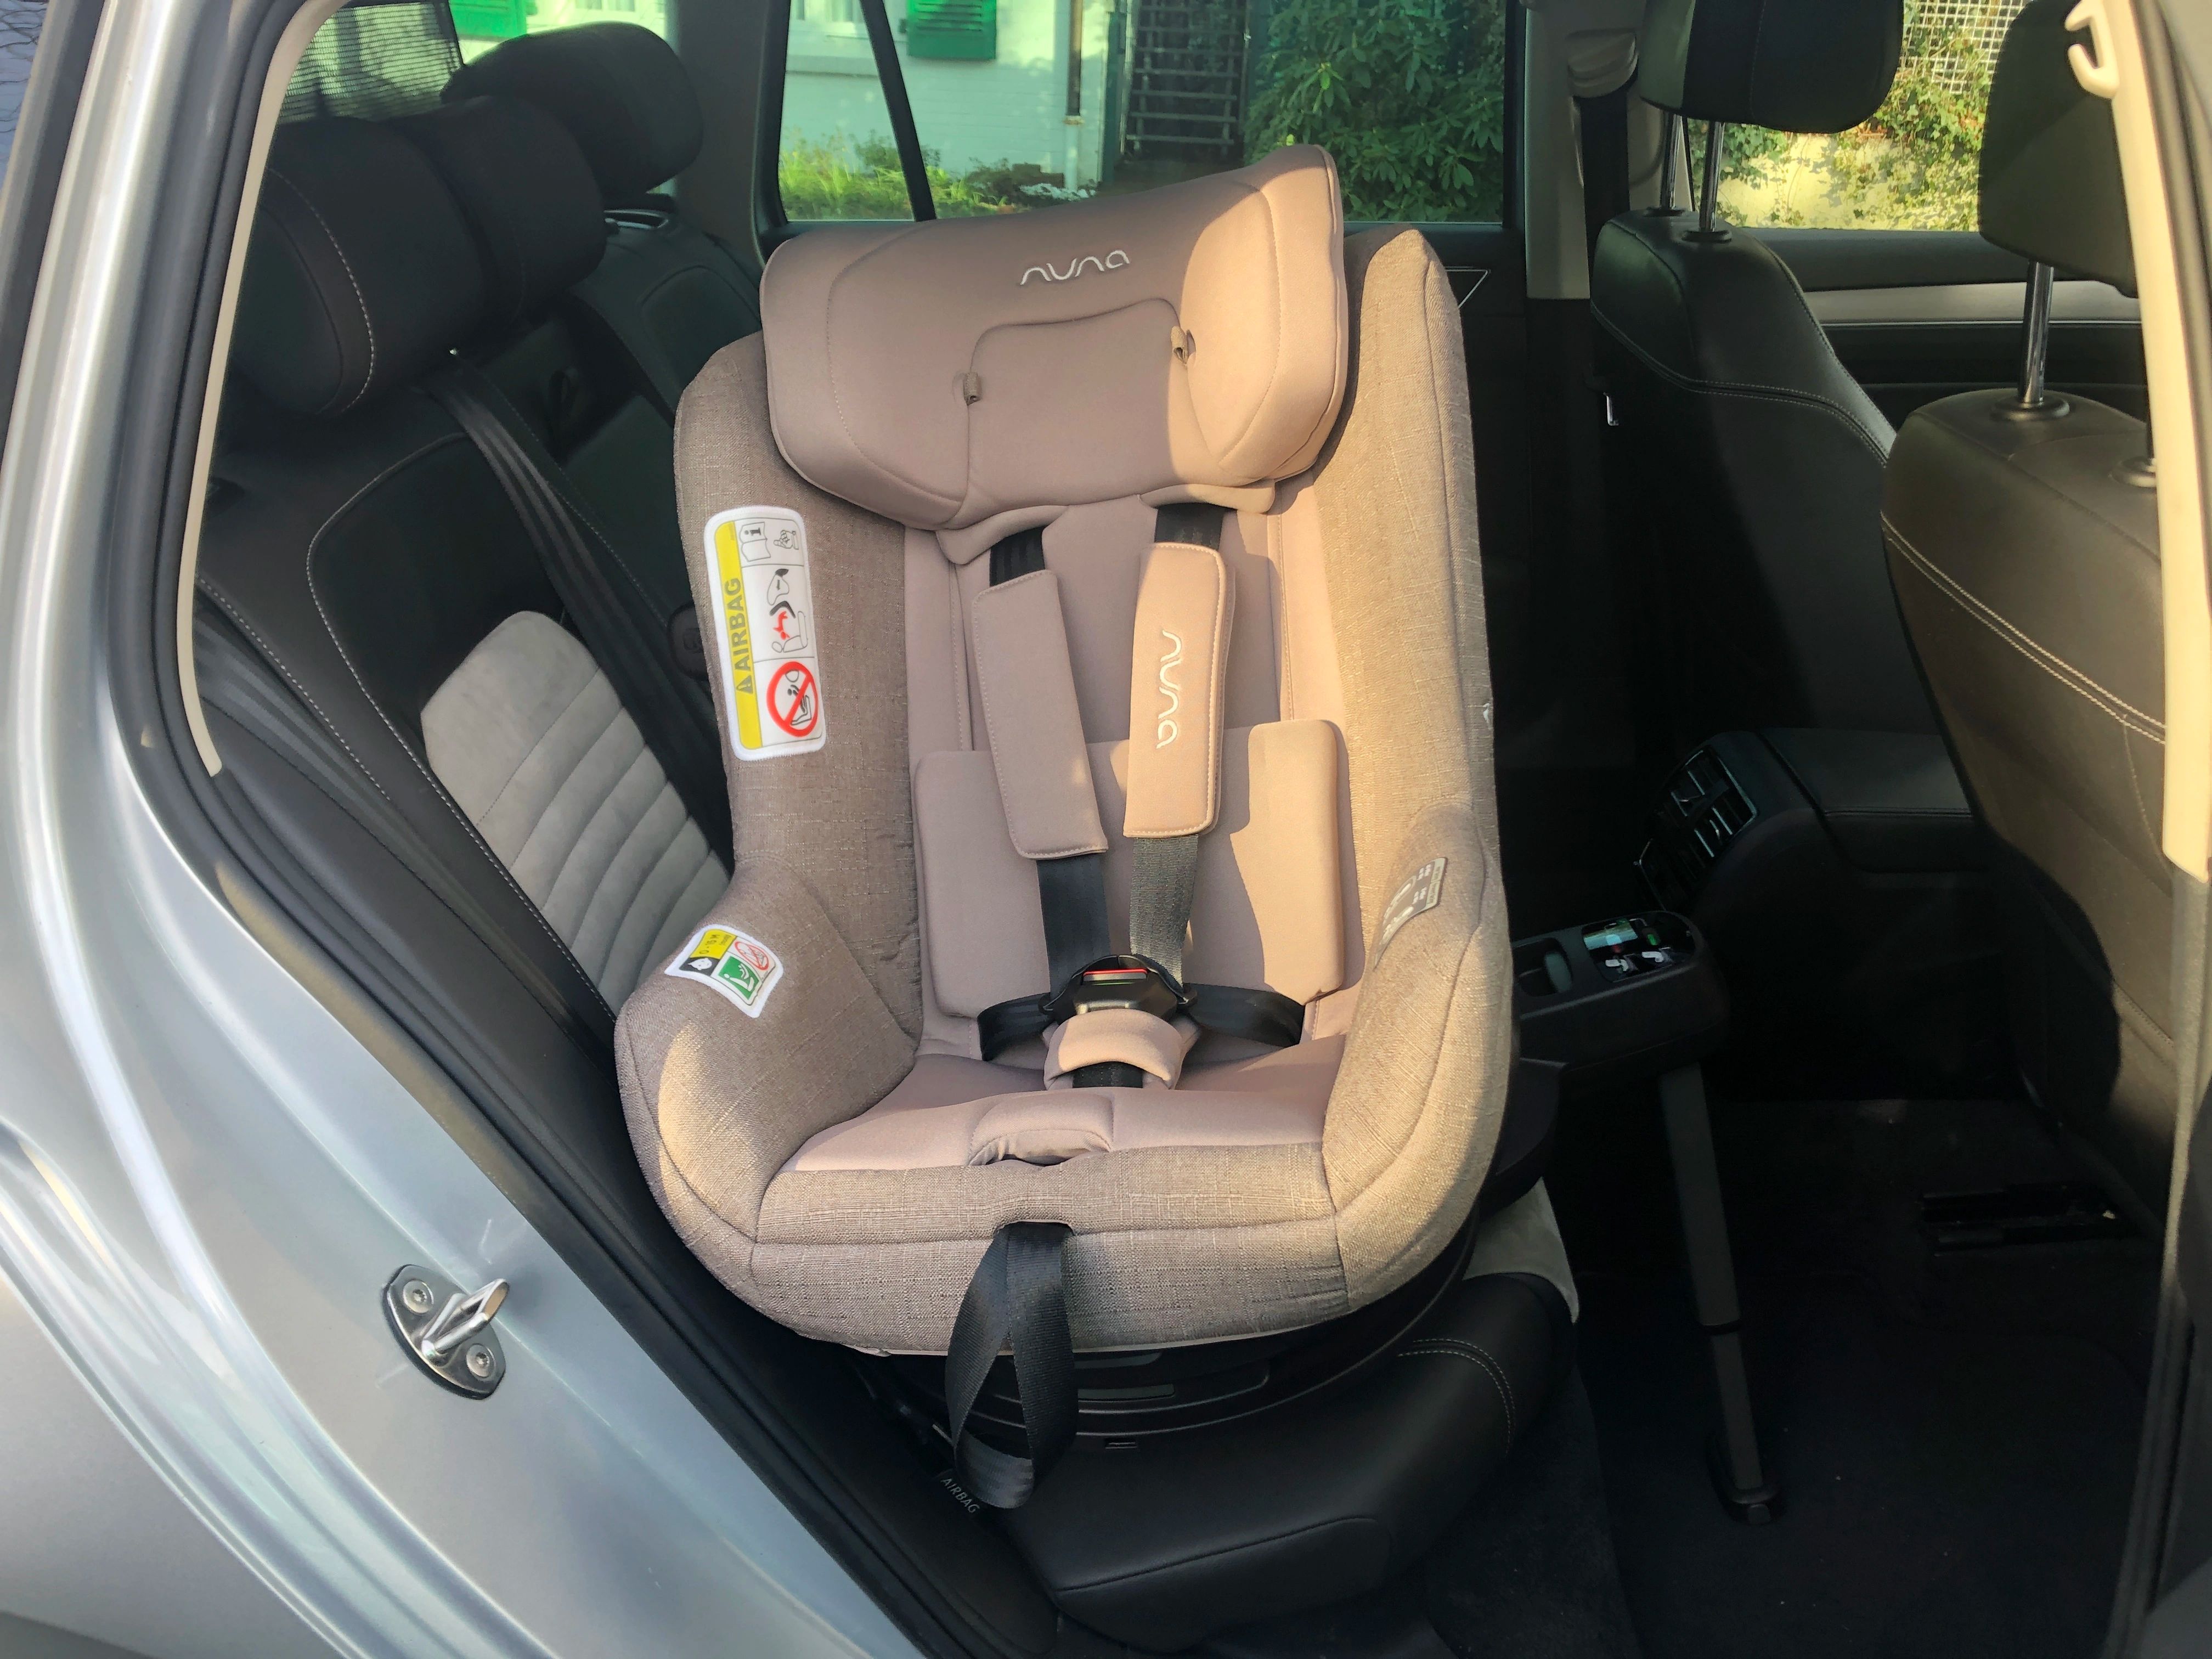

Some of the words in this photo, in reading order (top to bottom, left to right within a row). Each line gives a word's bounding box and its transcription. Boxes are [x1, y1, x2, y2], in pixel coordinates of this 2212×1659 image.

[1020, 250, 1130, 285] nuna
[724, 578, 751, 672] AIRBAG
[1155, 629, 1183, 749] nuna
[940, 1478, 980, 1514] AIRBAG
